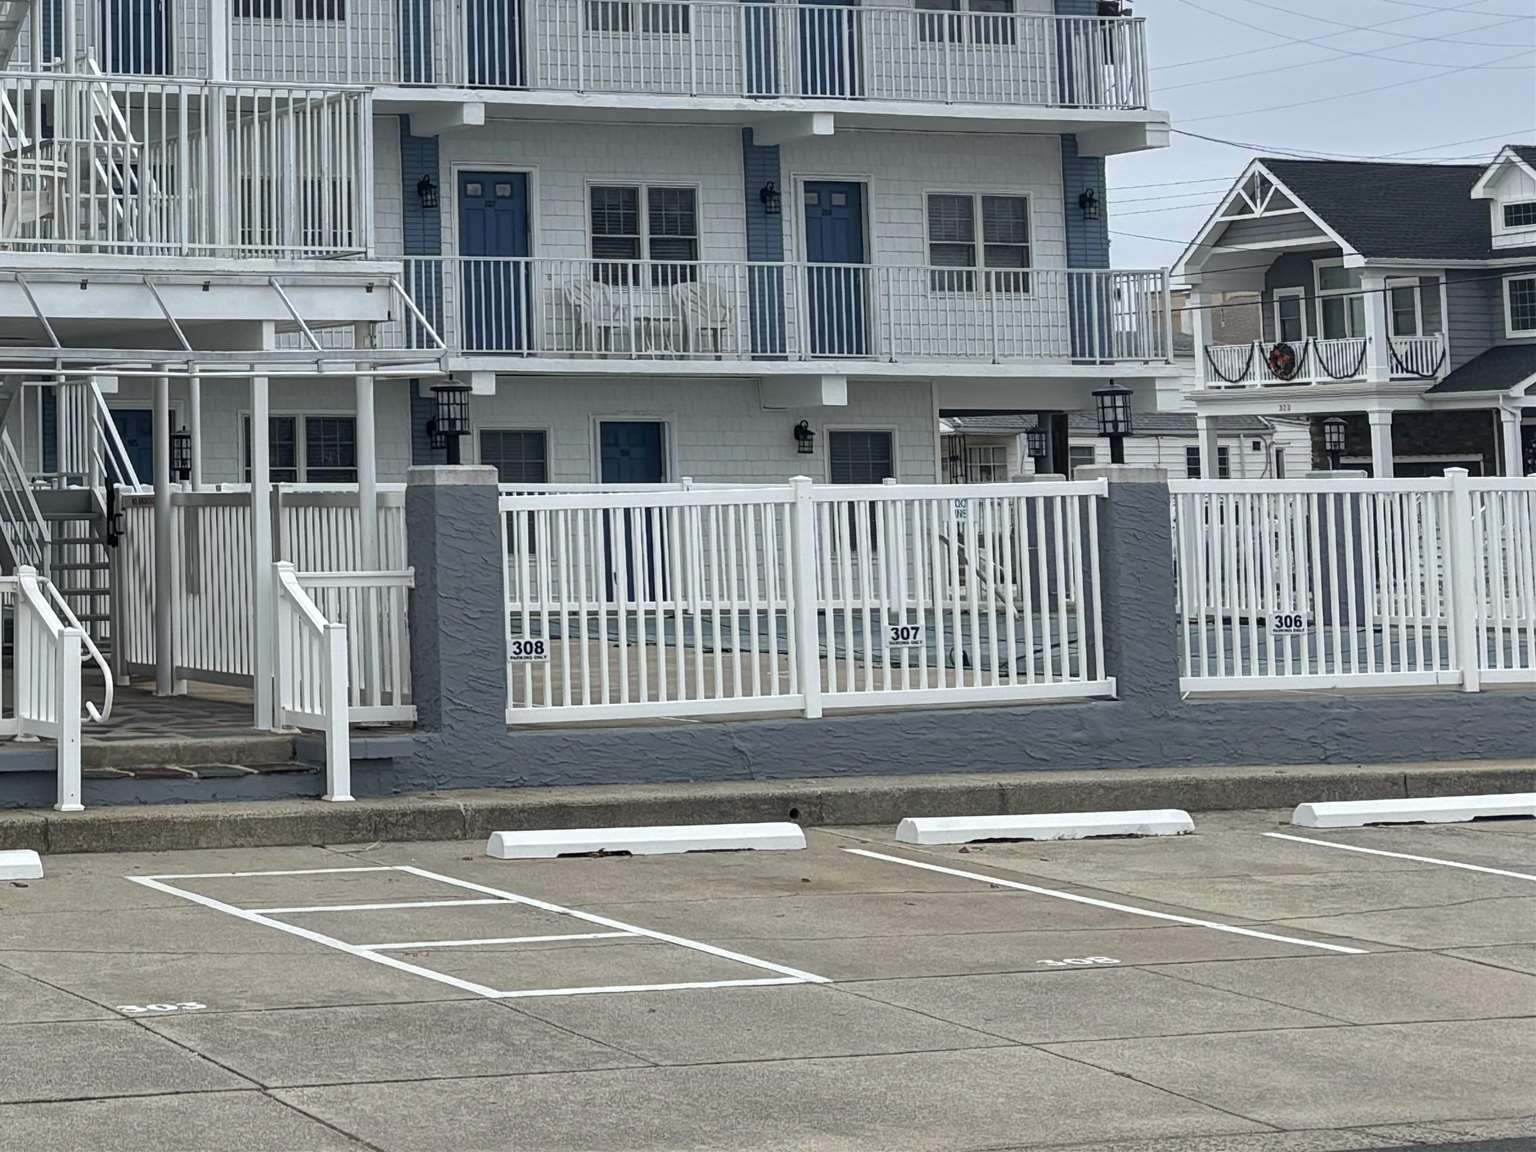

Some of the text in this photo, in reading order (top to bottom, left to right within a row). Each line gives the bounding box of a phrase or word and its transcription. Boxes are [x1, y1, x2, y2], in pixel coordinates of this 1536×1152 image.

[1275, 614, 1303, 629] 306
[890, 626, 920, 641] 307
[512, 640, 545, 656] 308
